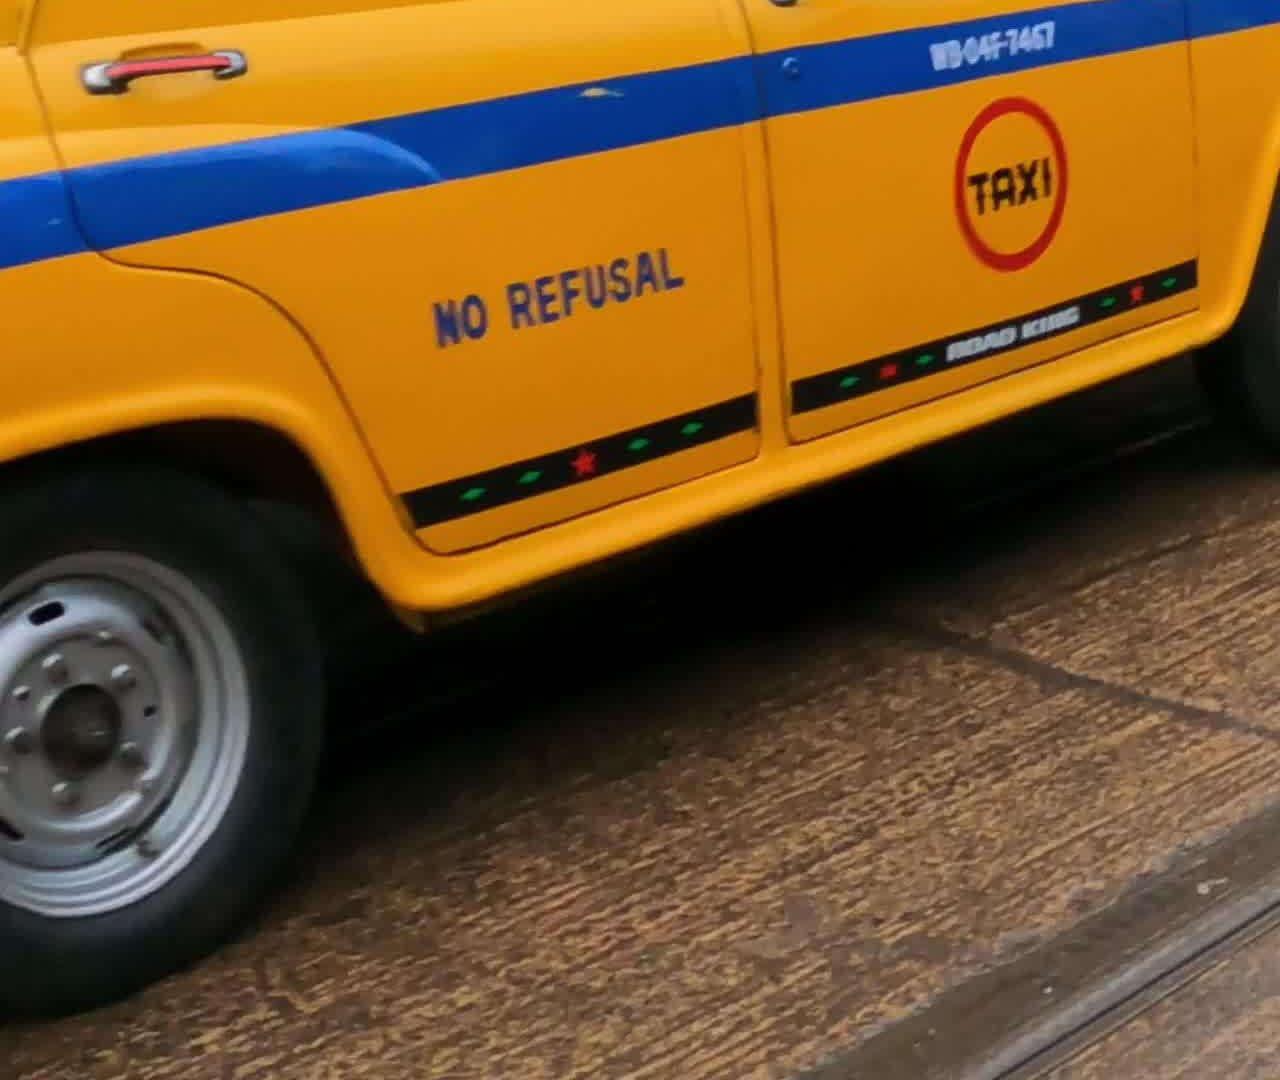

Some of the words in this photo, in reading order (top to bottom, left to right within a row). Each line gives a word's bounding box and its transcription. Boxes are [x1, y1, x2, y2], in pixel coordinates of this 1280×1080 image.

[968, 157, 1053, 216] TAXI
[433, 294, 488, 349] NO
[506, 247, 685, 330] REFUSAL
